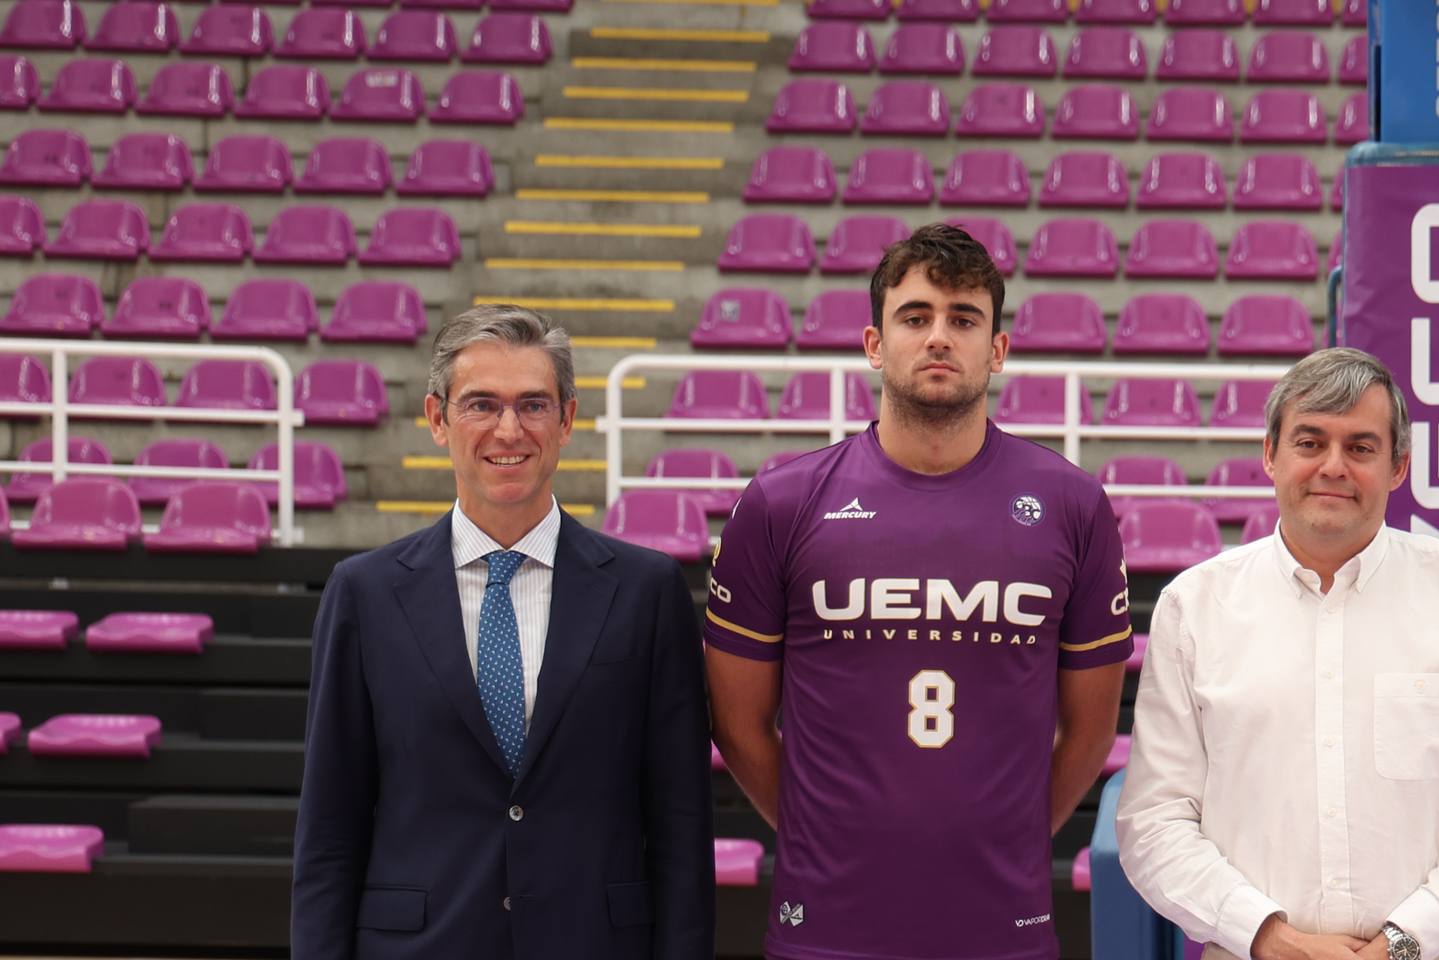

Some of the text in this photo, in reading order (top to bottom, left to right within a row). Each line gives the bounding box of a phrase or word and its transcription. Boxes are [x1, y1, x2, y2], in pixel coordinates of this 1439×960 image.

[823, 511, 877, 520] MERCURY
[811, 577, 1053, 627] UEMC
[823, 629, 1037, 646] UNIVERSIDAD
[907, 669, 955, 749] 8
